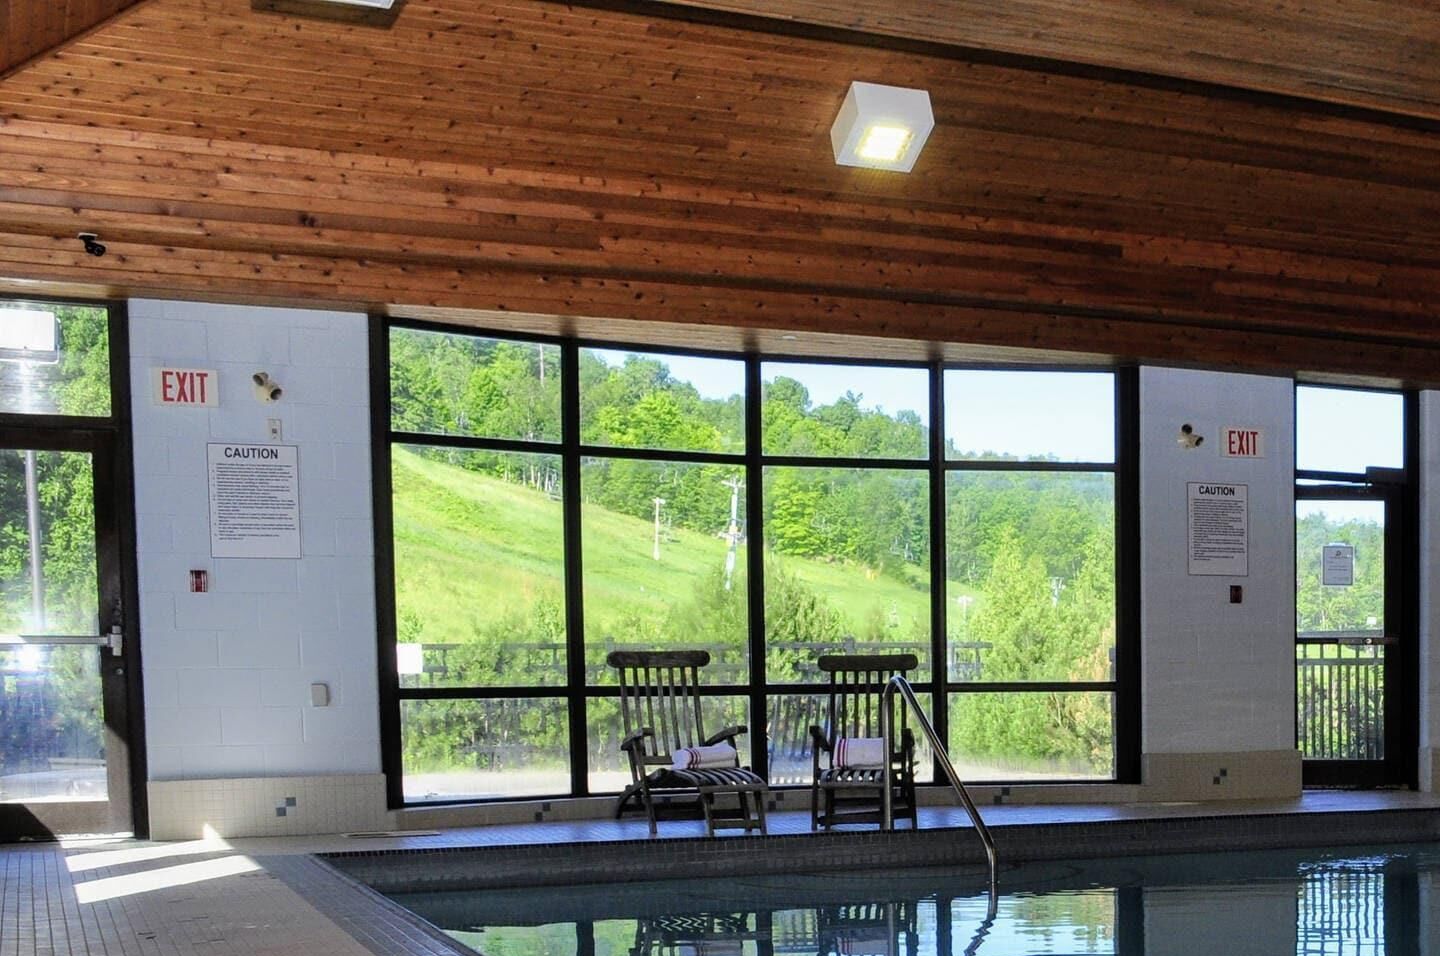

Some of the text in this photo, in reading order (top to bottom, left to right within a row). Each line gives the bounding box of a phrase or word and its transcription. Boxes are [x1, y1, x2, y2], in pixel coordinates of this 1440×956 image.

[161, 371, 208, 403] EXIT
[1228, 430, 1259, 456] EXIT
[224, 447, 278, 459] CAUTION
[1198, 486, 1236, 496] CAUTION
